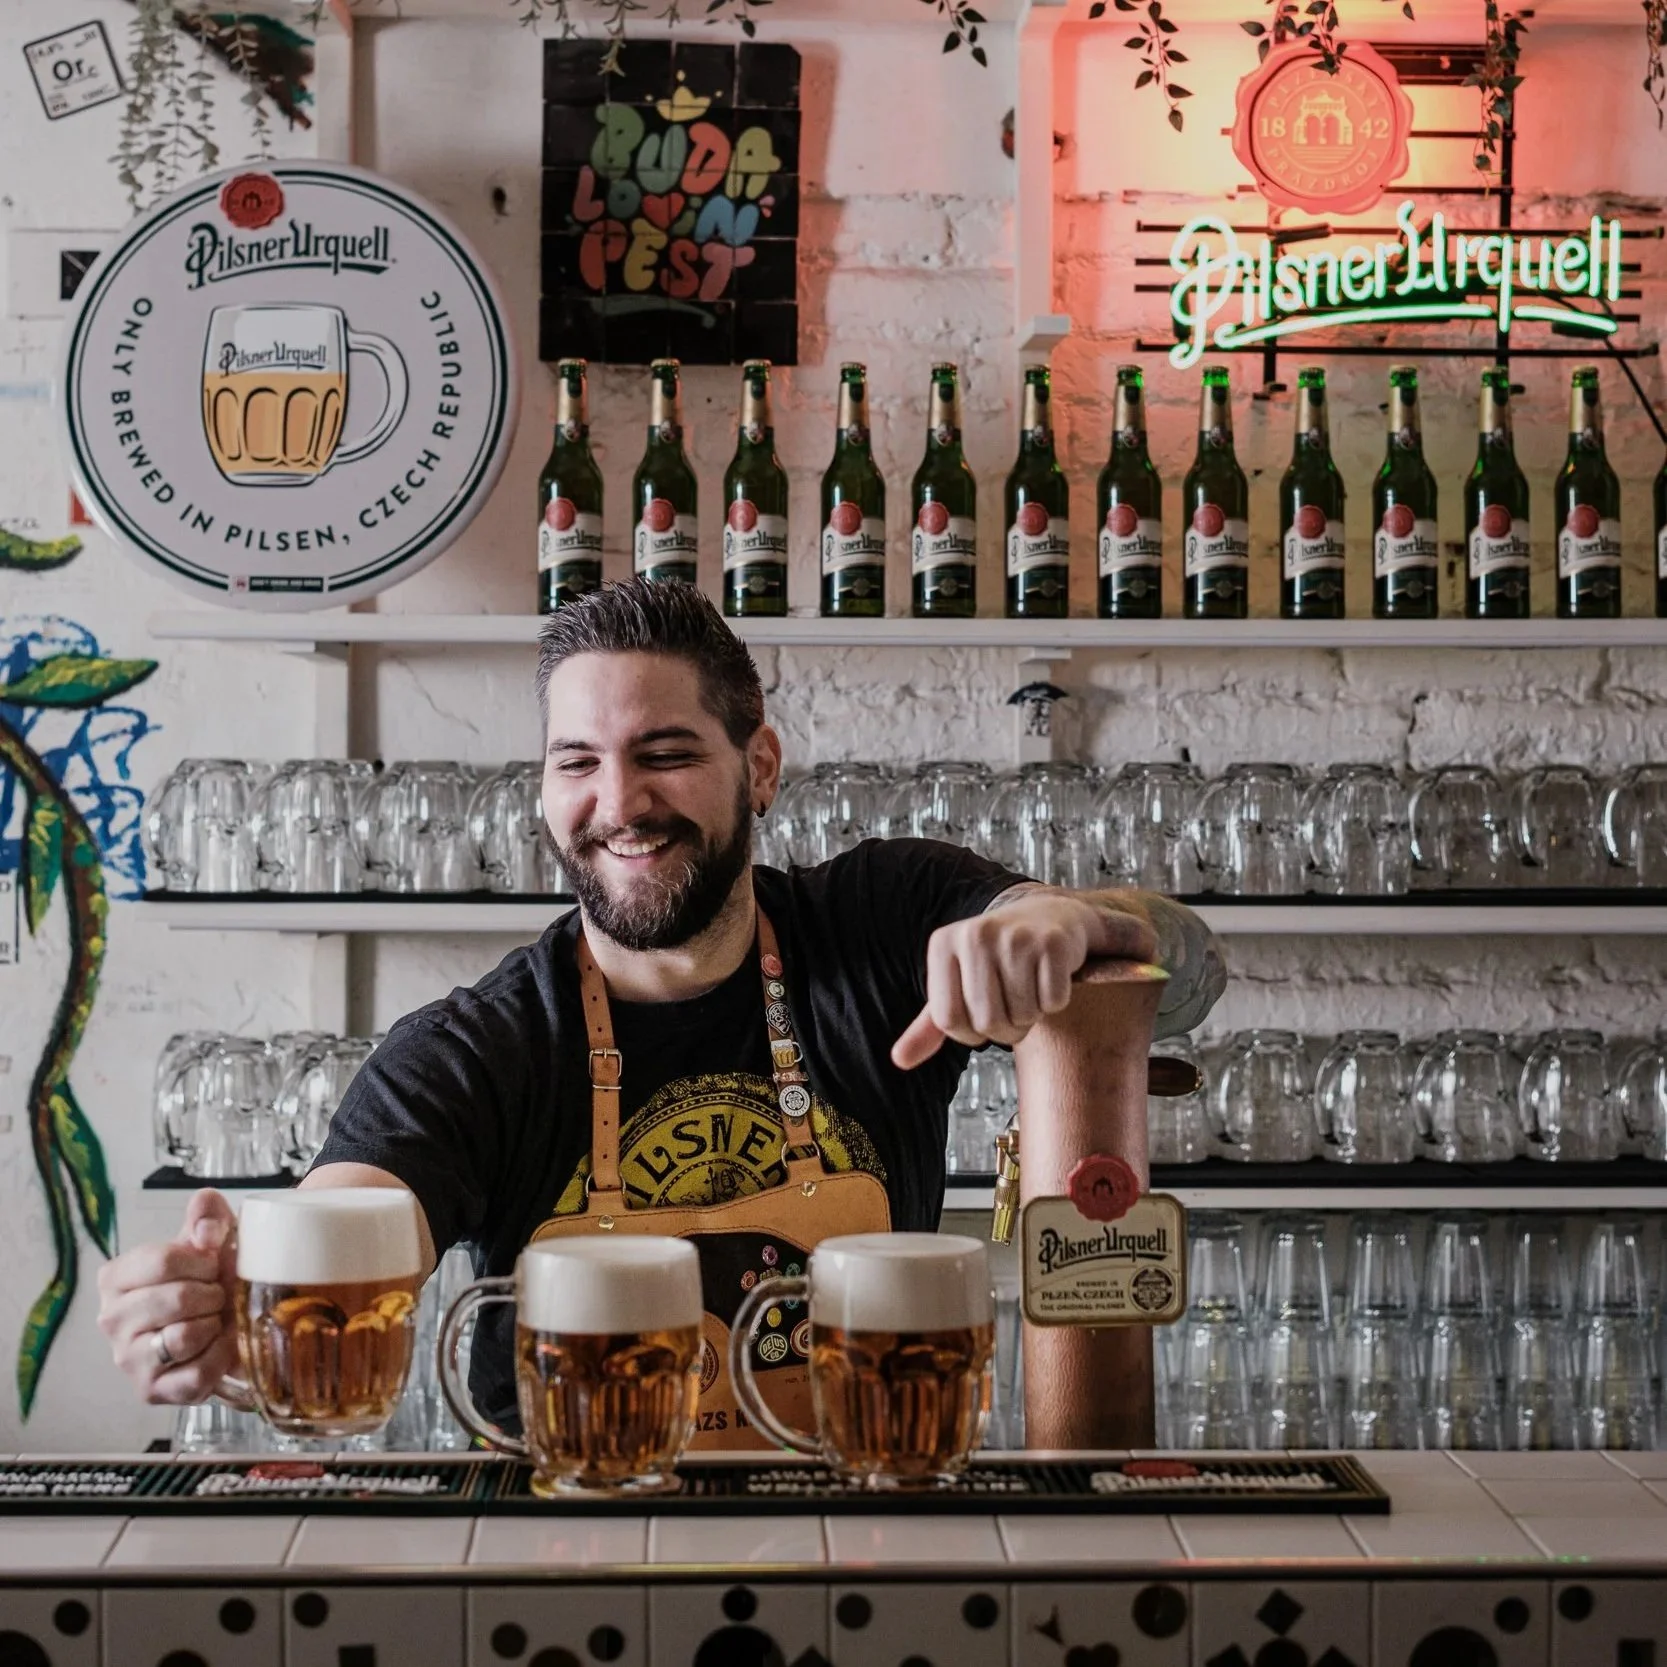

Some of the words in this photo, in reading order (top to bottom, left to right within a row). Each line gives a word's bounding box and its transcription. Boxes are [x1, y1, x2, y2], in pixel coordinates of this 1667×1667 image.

[591, 102, 781, 199] BUDA
[1260, 117, 1286, 138] 18
[1358, 117, 1389, 139] 42
[185, 222, 291, 290] Pilsner
[289, 219, 389, 275] Urquell
[580, 218, 755, 301] PEST
[1169, 216, 1403, 369] Pilsner
[1397, 201, 1620, 332] Urquell
[113, 297, 152, 376] ONLY
[219, 342, 273, 378] Pilsner
[274, 341, 326, 370] Urquell
[420, 291, 462, 439] REPUBLIC
[111, 390, 174, 503] BREWED
[180, 504, 214, 533] IN
[359, 449, 440, 528] CZECH
[225, 525, 350, 551] PILSEN,
[1038, 1227, 1104, 1275] Pilsner
[1103, 1225, 1167, 1262] Urquell
[1083, 1289, 1124, 1299] CZECH
